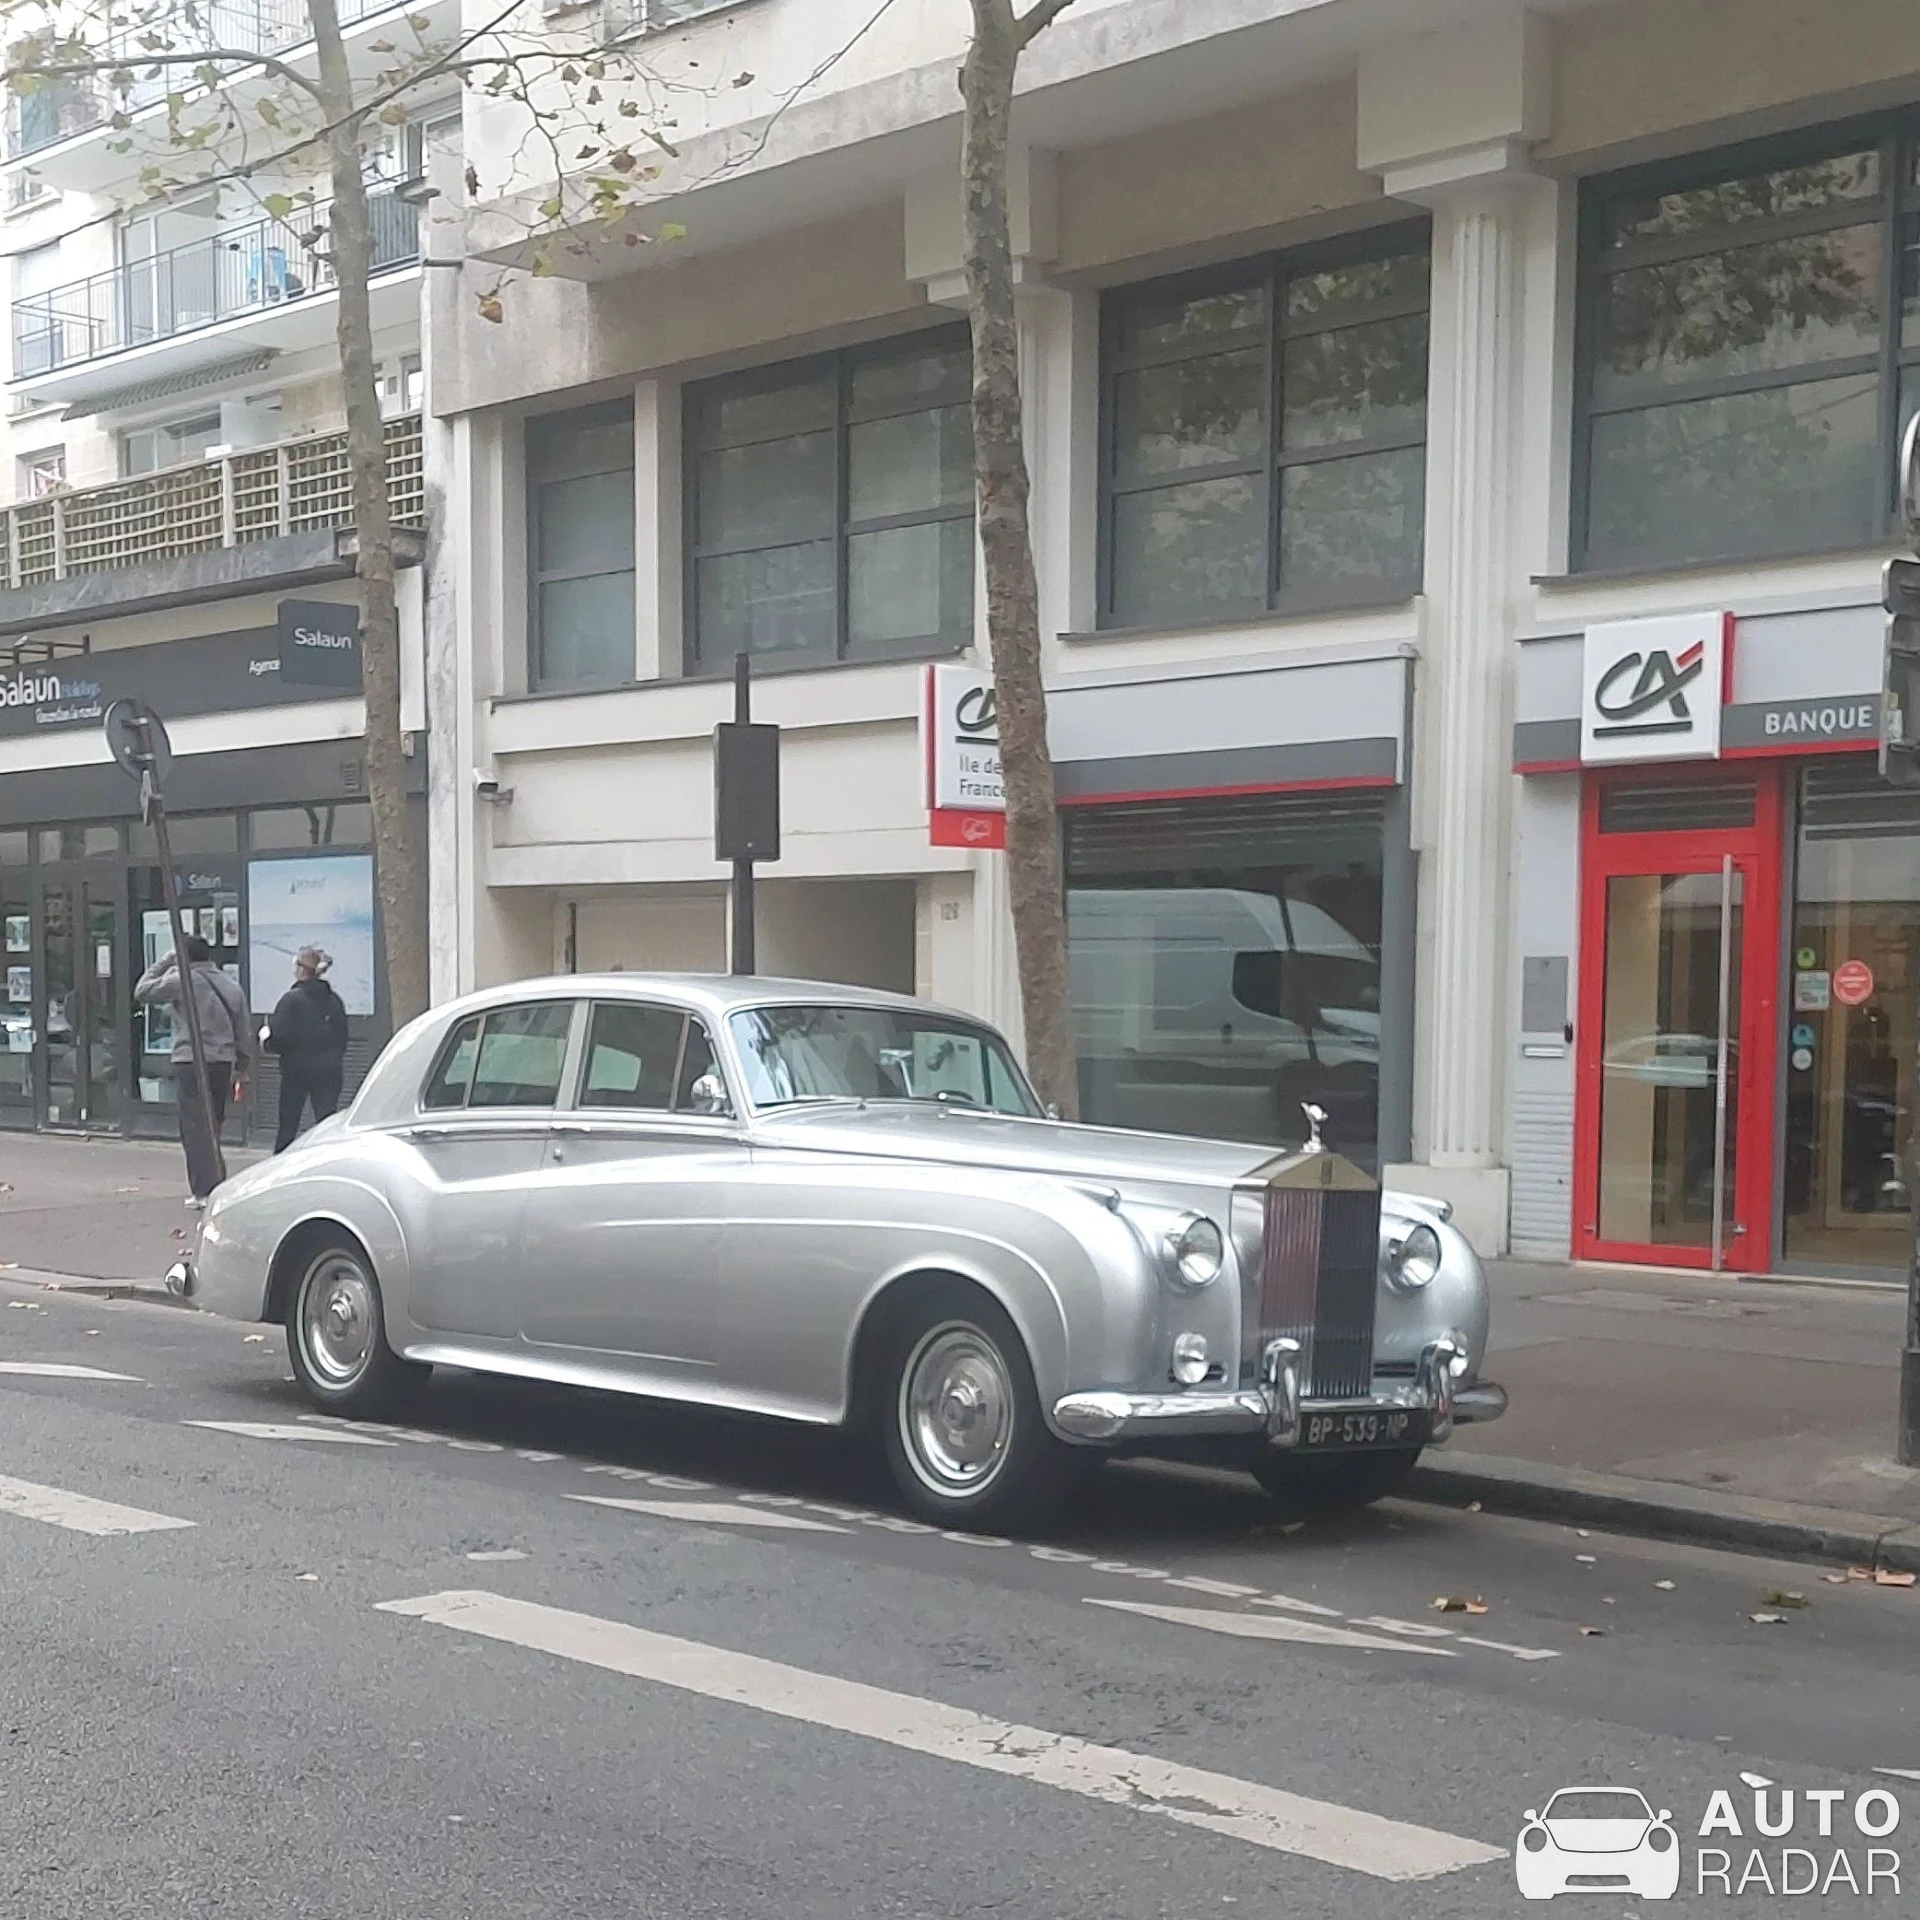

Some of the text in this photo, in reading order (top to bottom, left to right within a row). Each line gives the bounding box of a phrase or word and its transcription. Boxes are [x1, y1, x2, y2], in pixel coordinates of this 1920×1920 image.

[294, 627, 352, 650] Salaun
[1763, 704, 1874, 736] BANQUE
[983, 758, 1003, 775] de
